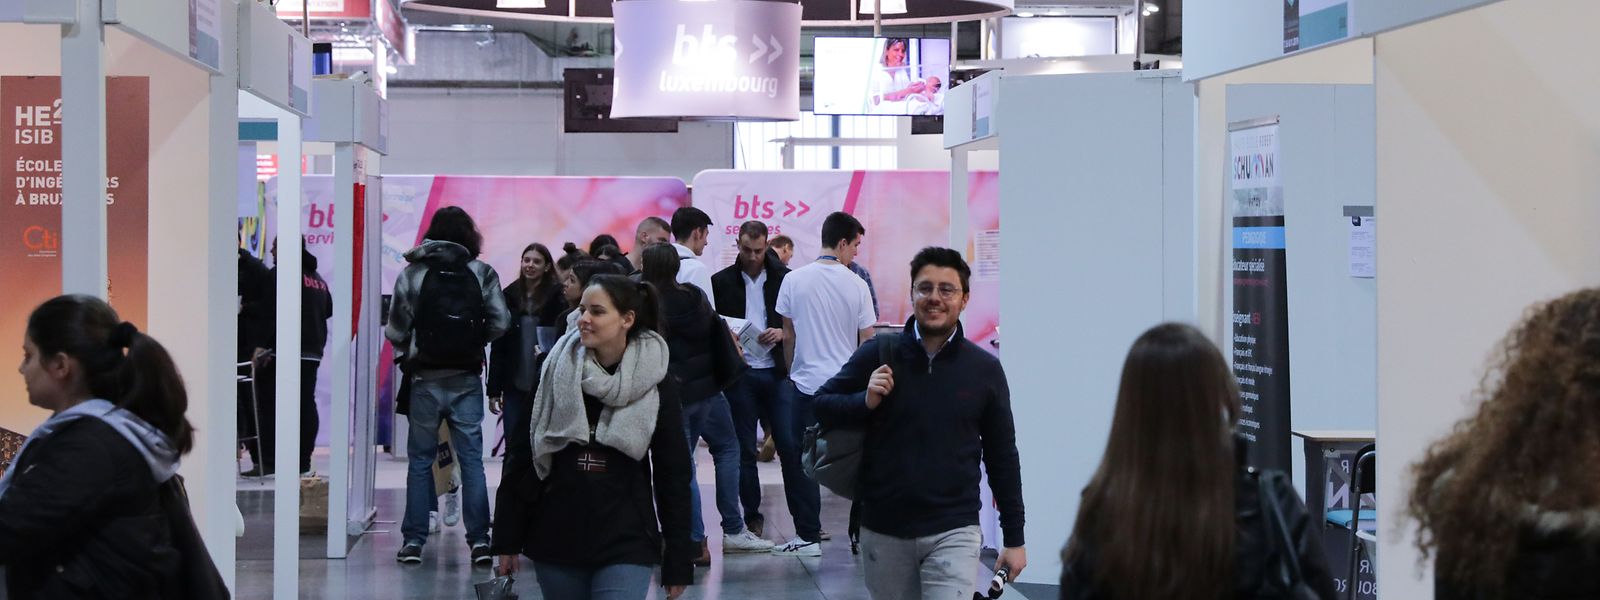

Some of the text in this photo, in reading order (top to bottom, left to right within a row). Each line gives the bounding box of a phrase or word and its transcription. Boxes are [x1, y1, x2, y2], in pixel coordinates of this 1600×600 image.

[672, 24, 738, 65] bts
[659, 70, 778, 98] luxembourg
[15, 129, 53, 144] ISIB
[16, 157, 62, 171] ÉCOLE
[15, 190, 26, 205] À
[734, 195, 774, 219] bts
[309, 203, 334, 228] bt
[725, 224, 781, 235] sees
